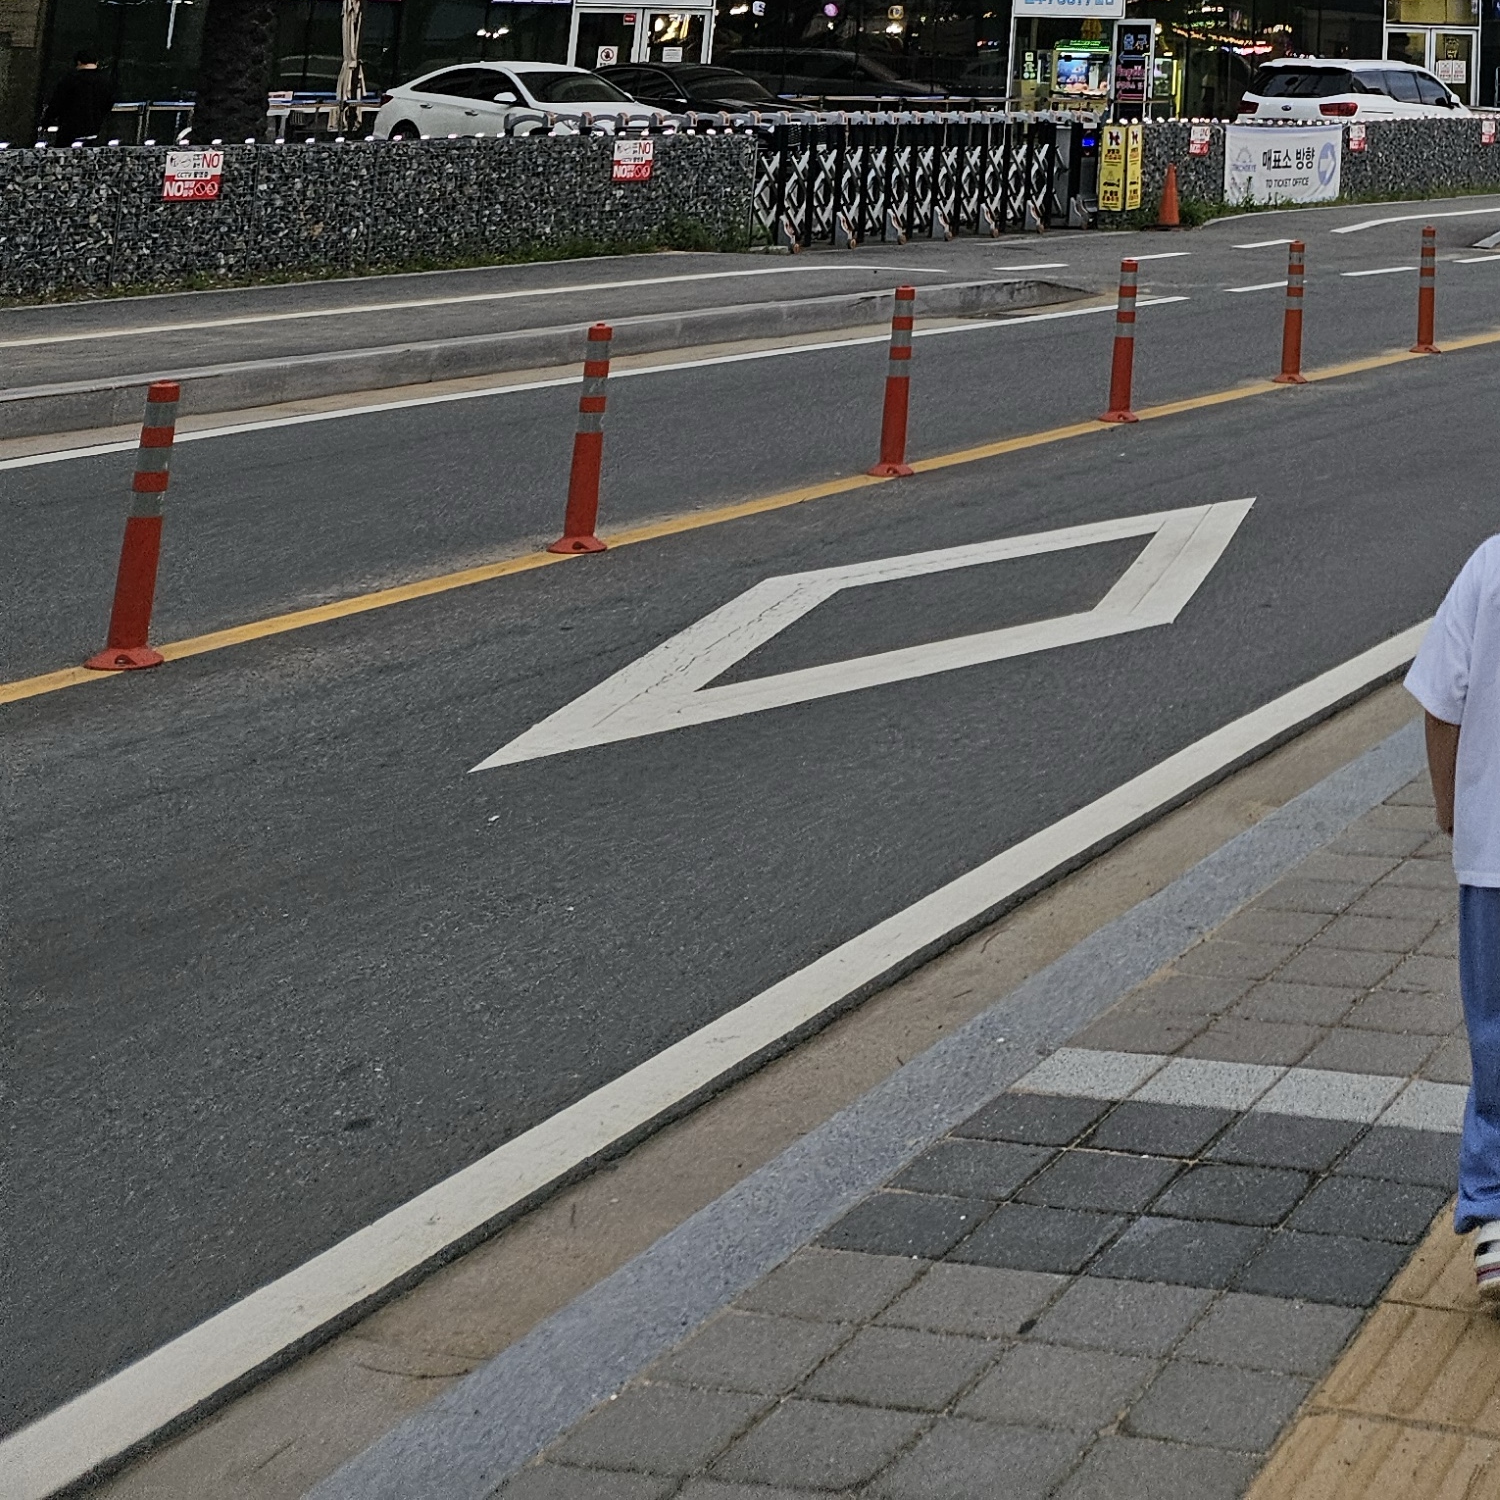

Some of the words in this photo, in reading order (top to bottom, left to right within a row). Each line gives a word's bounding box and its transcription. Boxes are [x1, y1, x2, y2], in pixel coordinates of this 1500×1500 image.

[202, 153, 220, 168] NO
[1262, 149, 1291, 170] 매표소
[1296, 147, 1315, 169] 방향
[163, 181, 184, 197] NO
